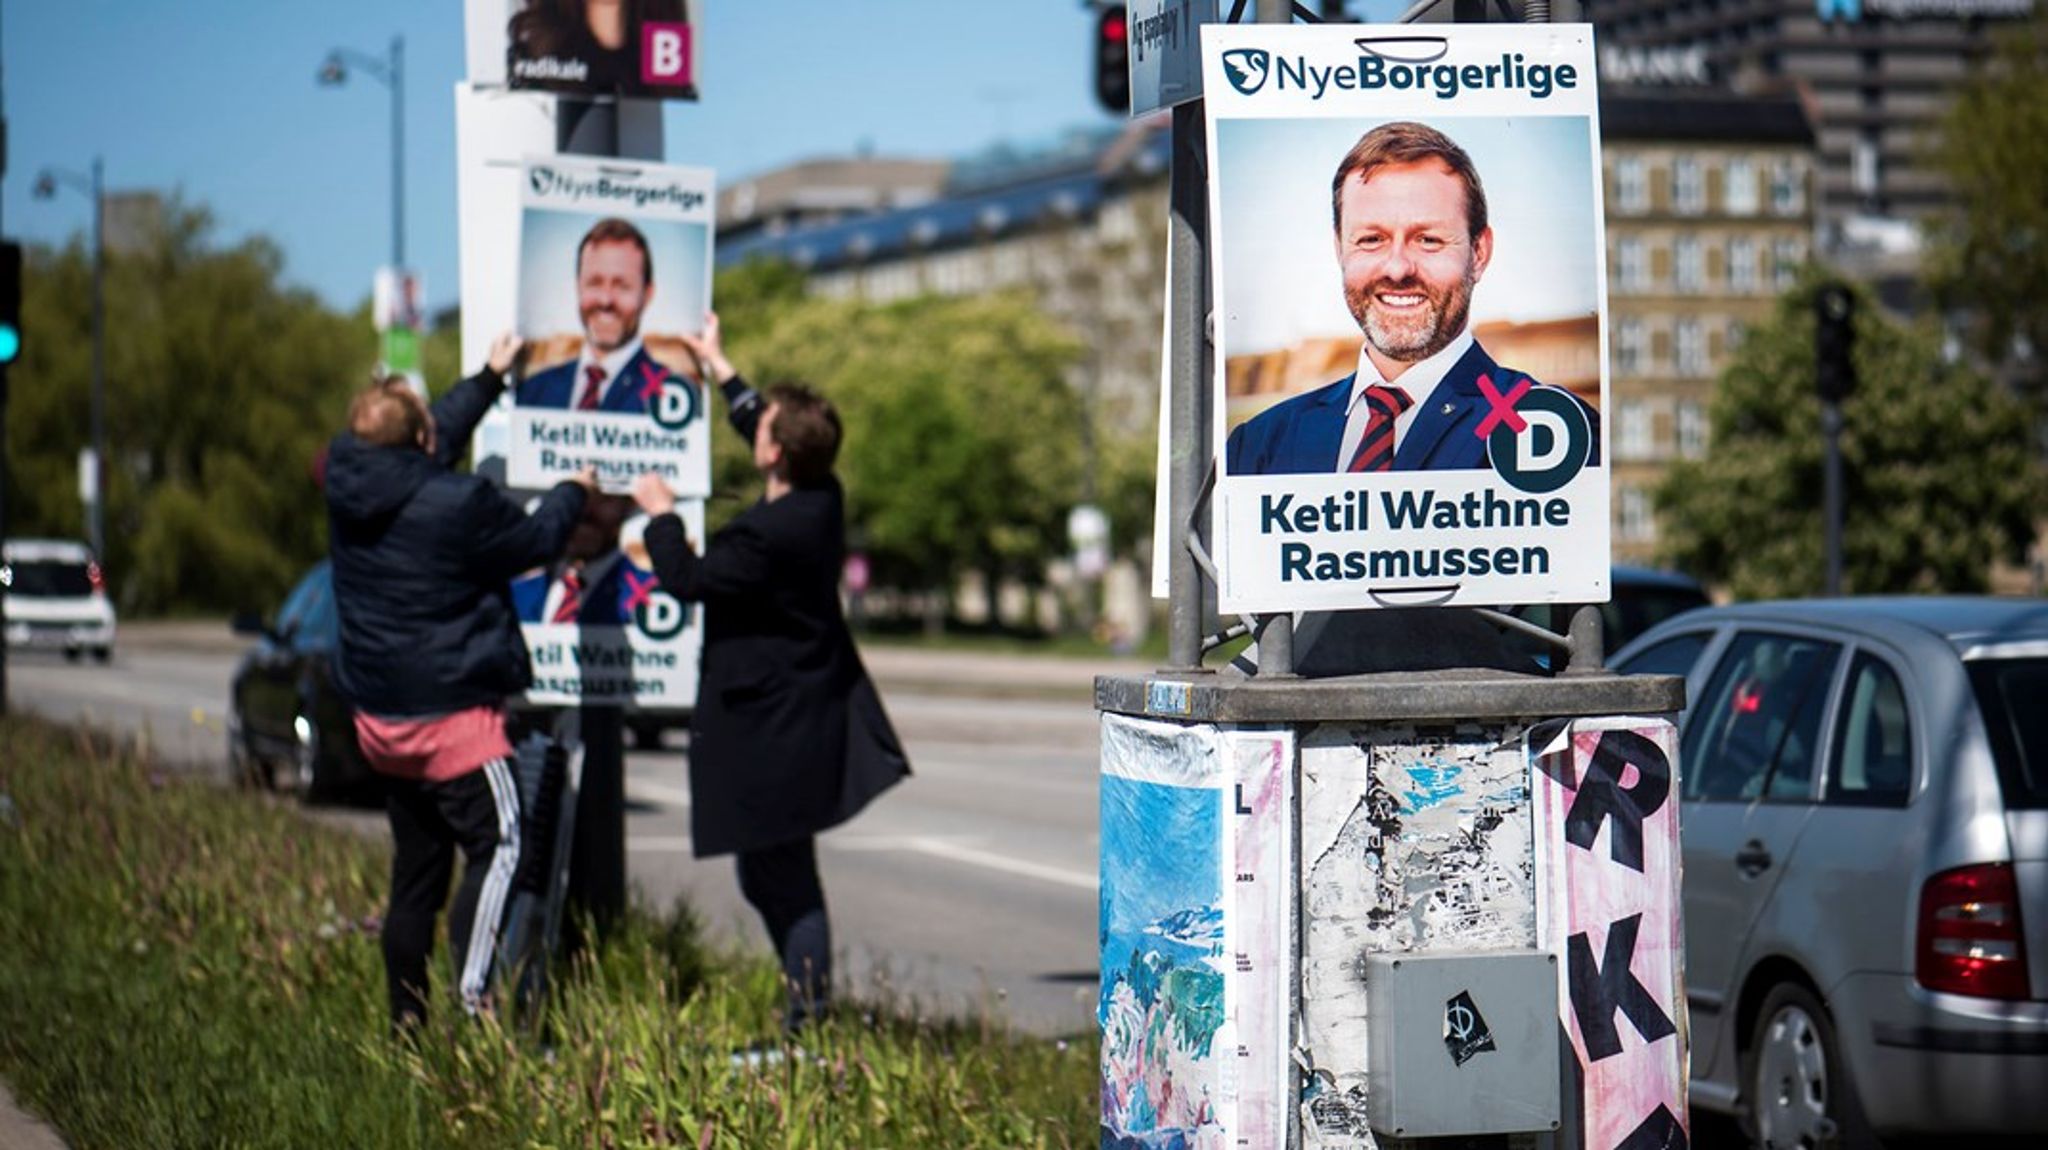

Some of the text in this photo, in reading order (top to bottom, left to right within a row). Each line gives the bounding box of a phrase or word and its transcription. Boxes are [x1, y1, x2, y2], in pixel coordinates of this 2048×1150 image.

[513, 55, 588, 81] radikale
[652, 30, 682, 76] B
[1276, 54, 1577, 100] NyeBorgerlige
[556, 174, 704, 209] NyeBorgerlige
[531, 419, 687, 452] Ketil Wathne
[1515, 409, 1570, 472] D
[1261, 488, 1570, 533] Ketil Wathne
[1281, 541, 1549, 582] Rasmussen
[570, 643, 677, 666] Wathne
[533, 677, 665, 696] asmussen
[1567, 912, 1676, 1062] K
